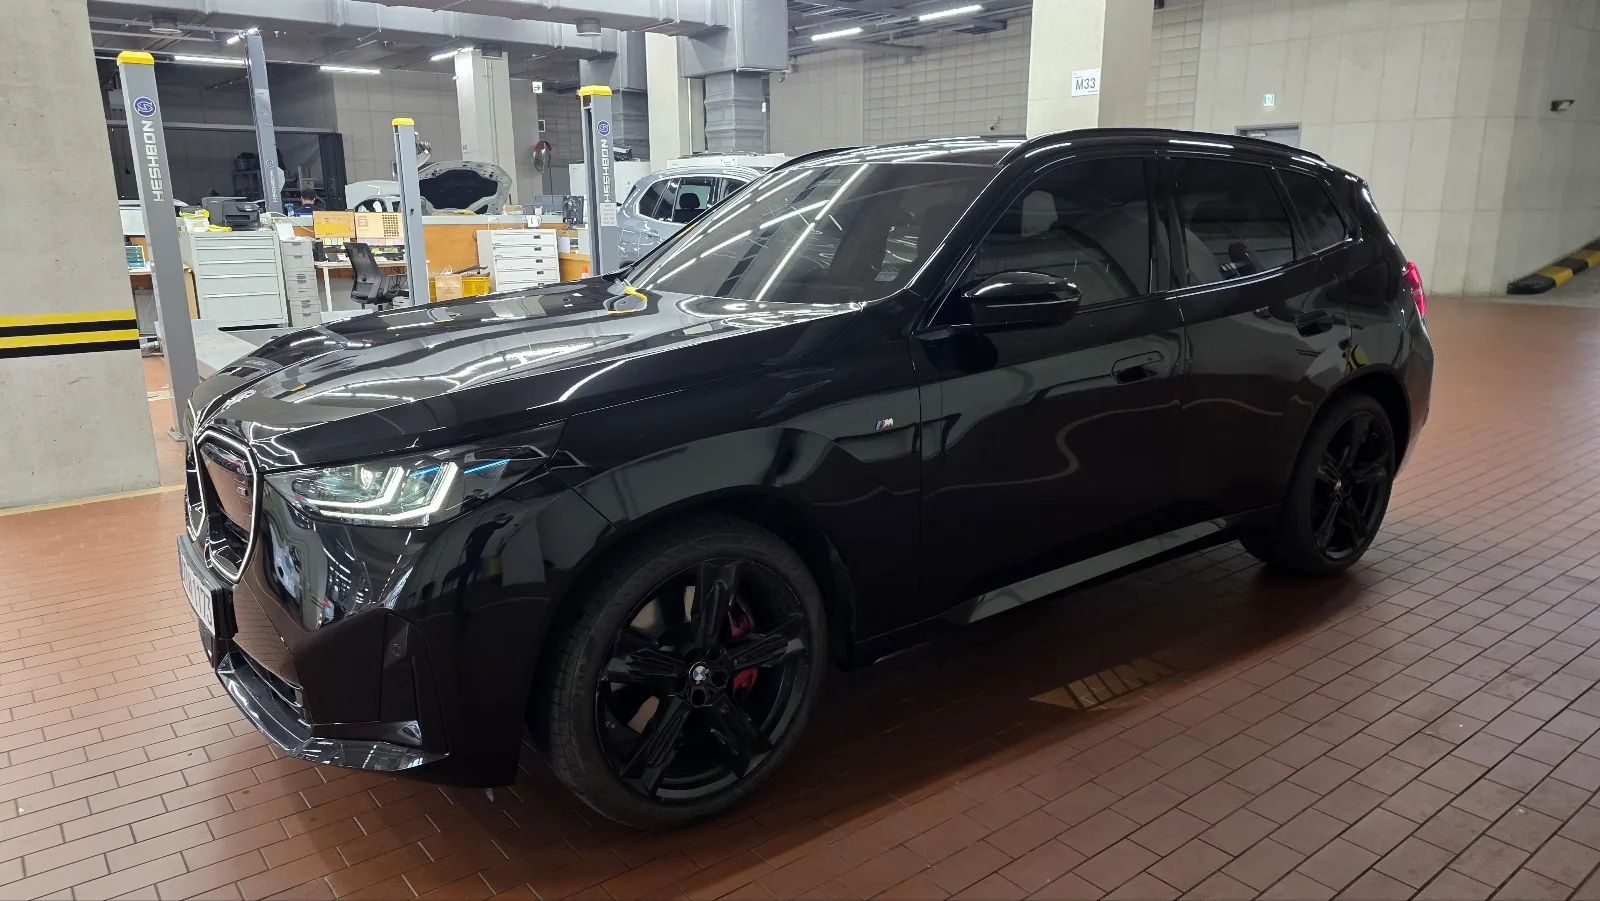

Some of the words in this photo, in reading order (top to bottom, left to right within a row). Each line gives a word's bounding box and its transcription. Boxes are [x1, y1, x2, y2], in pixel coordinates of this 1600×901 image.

[1075, 78, 1096, 91] M33
[141, 120, 165, 202] HESHBON
[600, 138, 612, 203] HESHBON
